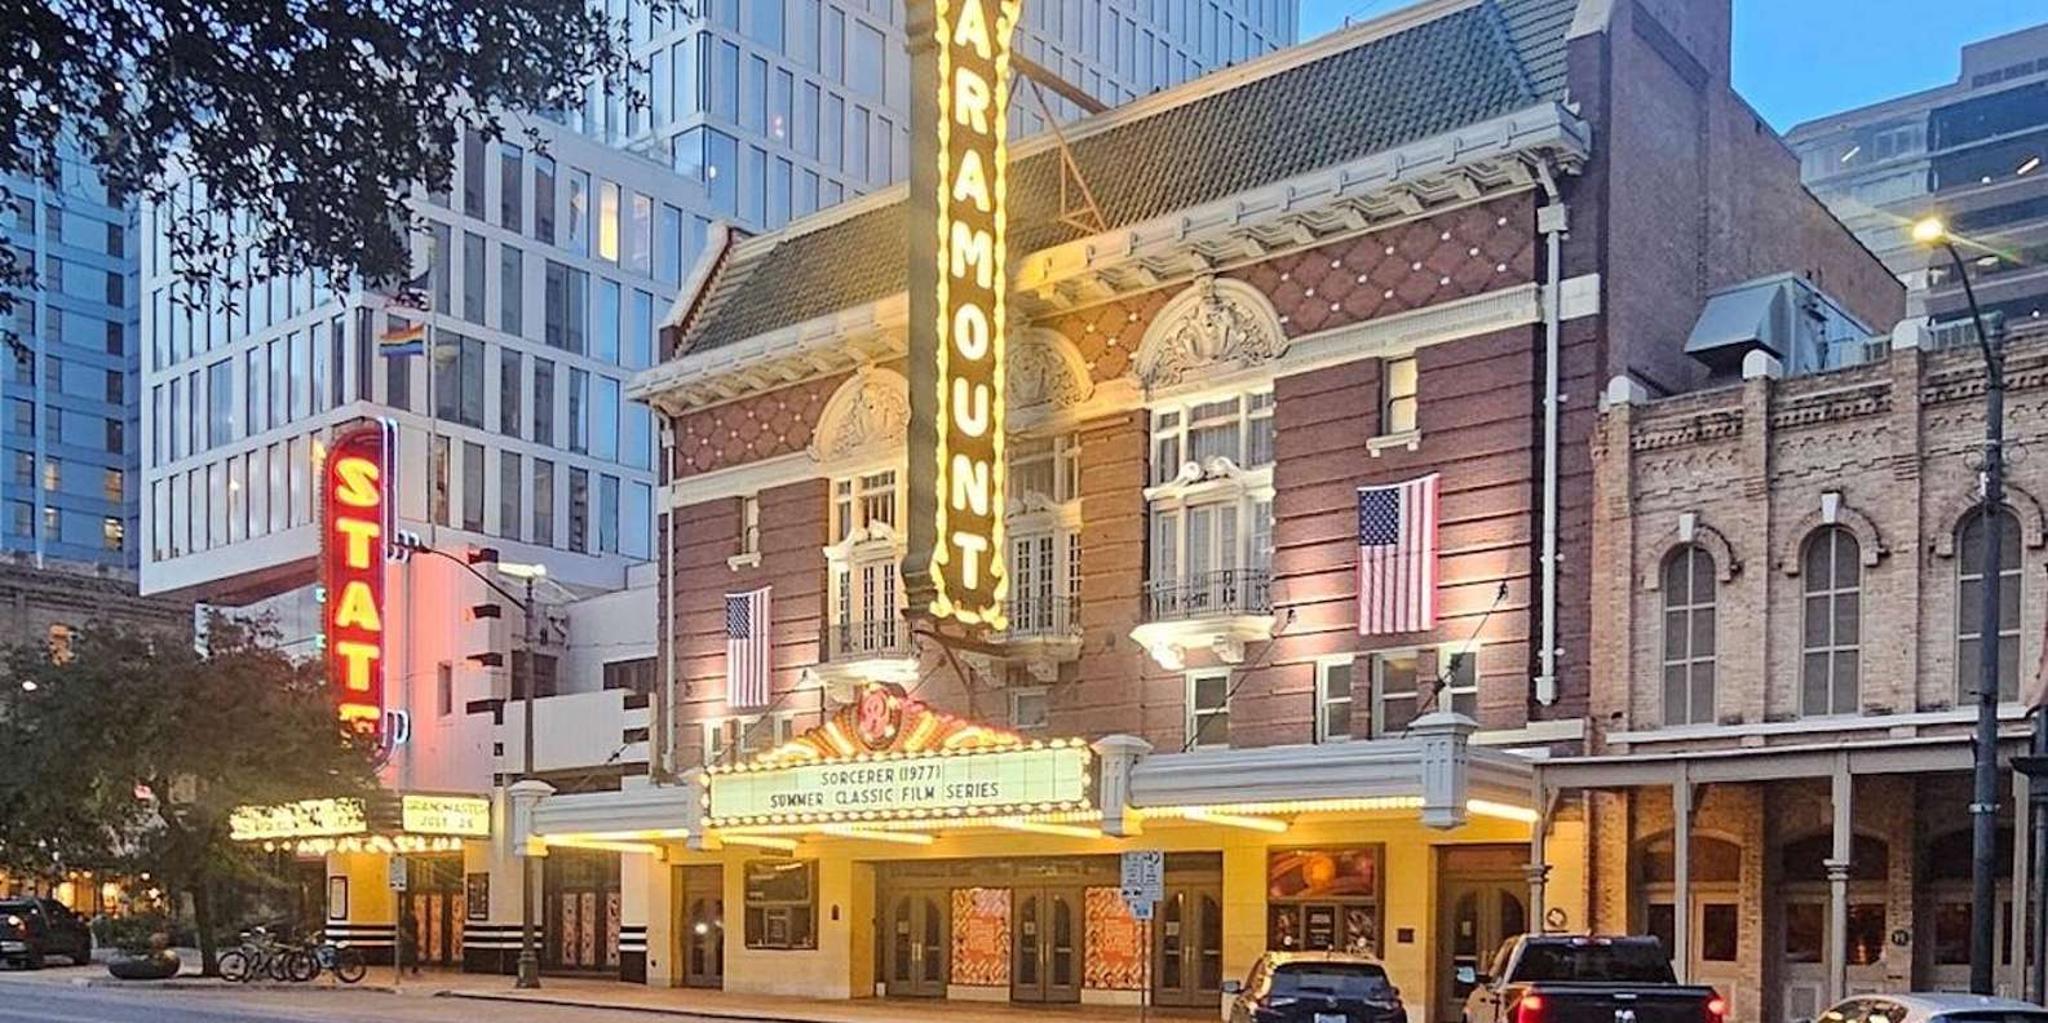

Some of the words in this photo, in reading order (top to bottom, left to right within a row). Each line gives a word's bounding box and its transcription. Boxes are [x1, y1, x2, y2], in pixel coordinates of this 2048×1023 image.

[821, 768, 895, 786] SORCERER
[899, 764, 941, 782] (1977)
[770, 792, 824, 809] SUMMER
[835, 787, 894, 805] CLASSIC
[901, 786, 935, 802] FILM
[945, 782, 999, 798] SERIES
